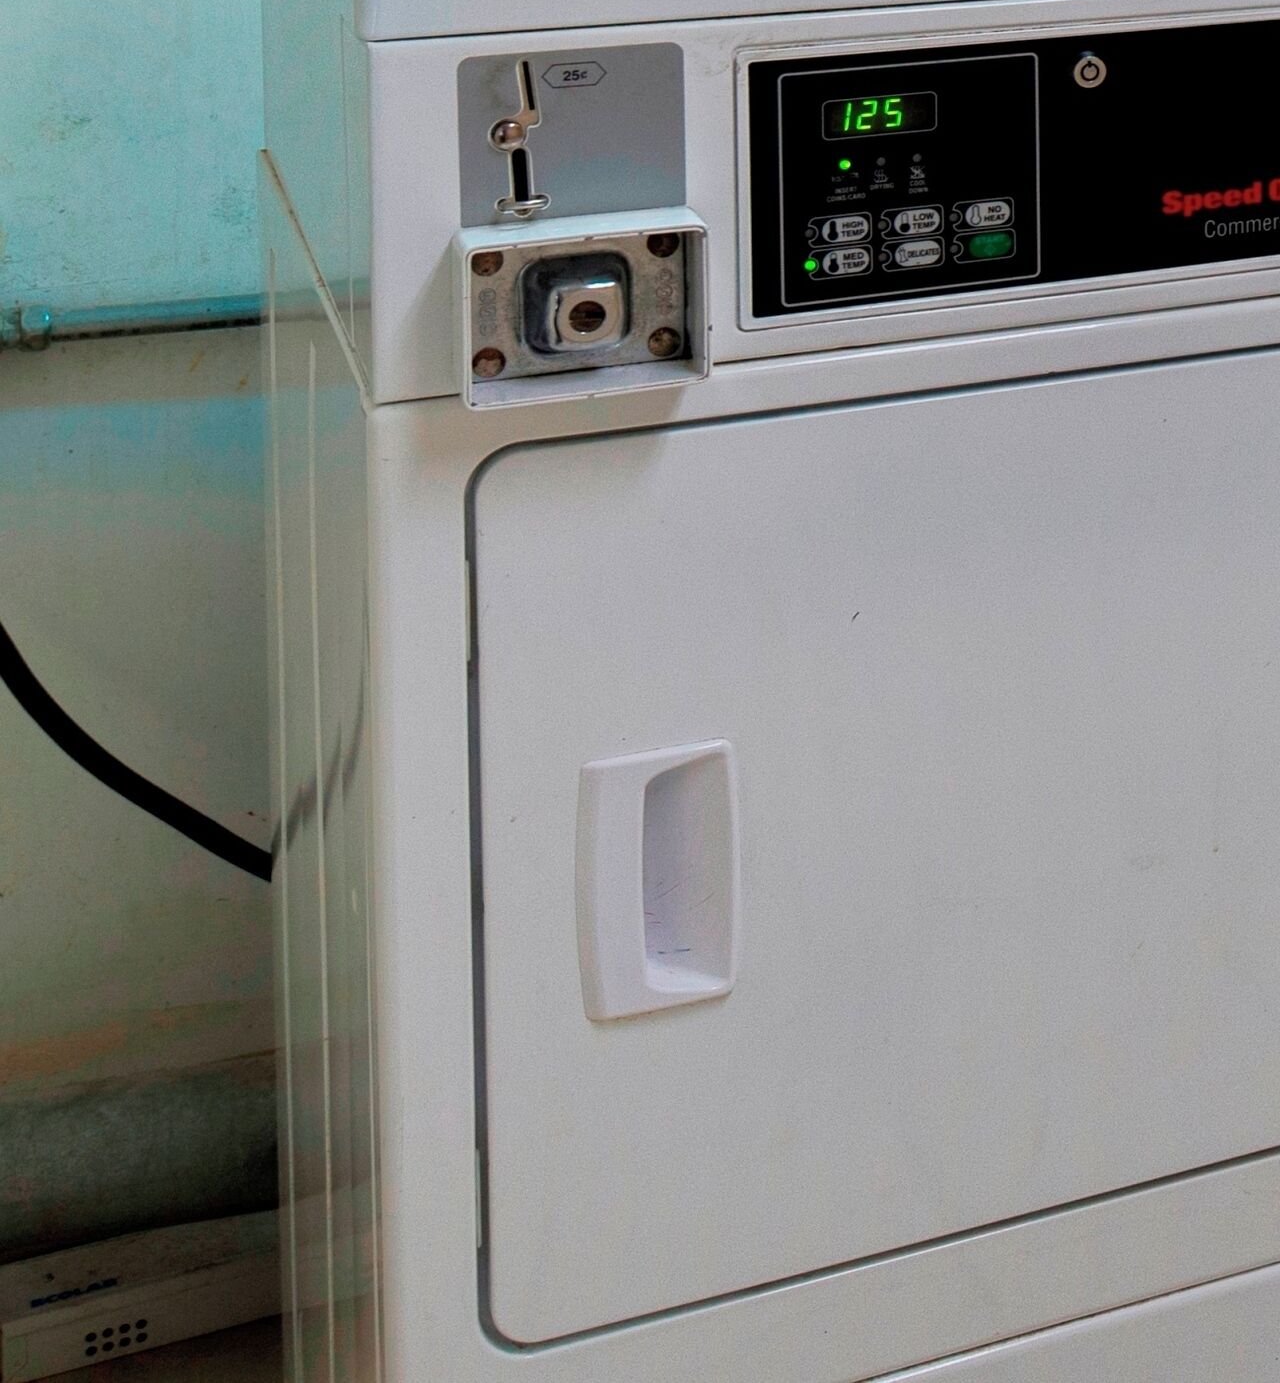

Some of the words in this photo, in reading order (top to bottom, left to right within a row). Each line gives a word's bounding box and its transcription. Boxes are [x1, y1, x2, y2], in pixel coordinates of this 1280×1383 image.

[843, 99, 903, 131] 125
[1162, 181, 1263, 217] Speed
[913, 213, 934, 221] LOW
[984, 213, 1006, 222] HEAT
[842, 221, 864, 229] HIGH
[912, 221, 936, 229] TEMP
[841, 228, 865, 237] TEMP
[843, 253, 864, 261] MED
[907, 248, 940, 258] DELICATES
[842, 260, 866, 269] TEMP
